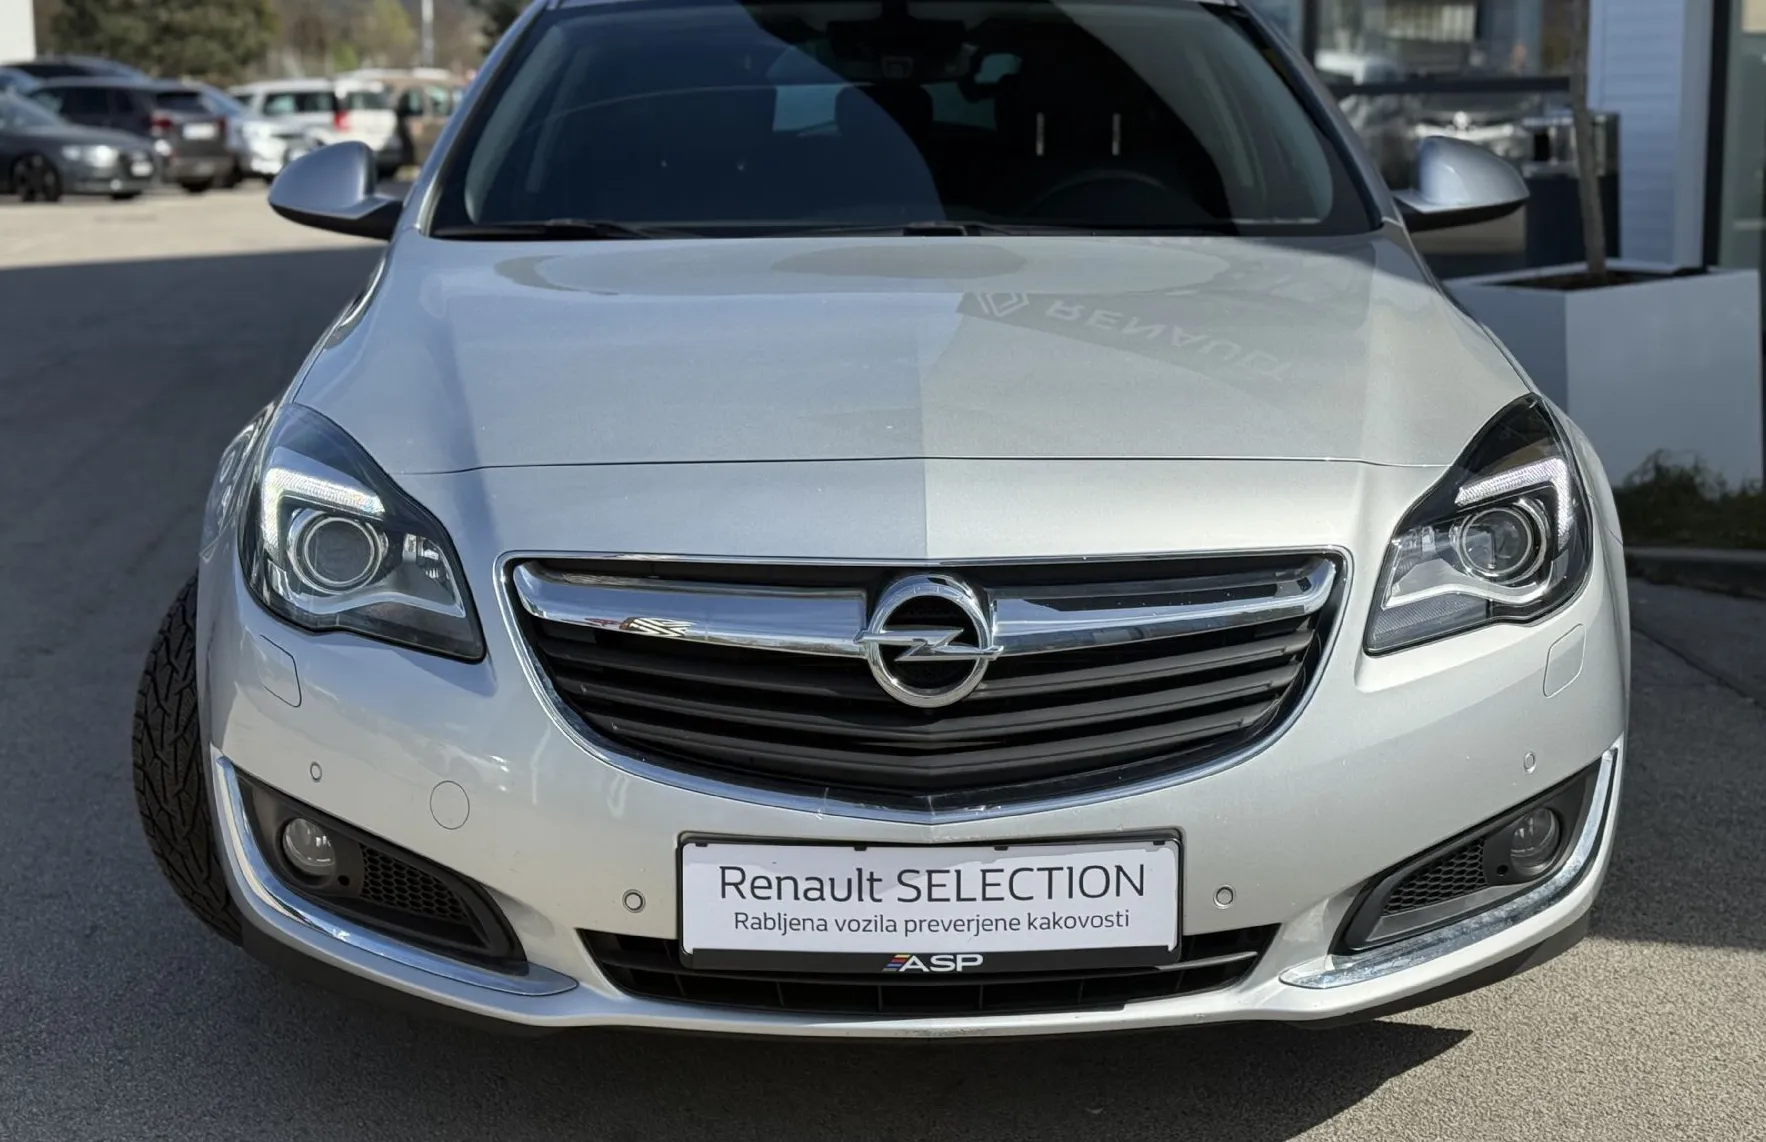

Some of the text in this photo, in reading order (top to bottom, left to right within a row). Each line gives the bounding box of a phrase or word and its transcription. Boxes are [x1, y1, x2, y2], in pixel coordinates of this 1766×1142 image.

[720, 864, 1144, 902] Renault SELECTION
[735, 910, 1128, 936] Rabljena vozila preverjene kakovosti
[898, 954, 983, 972] ASP
